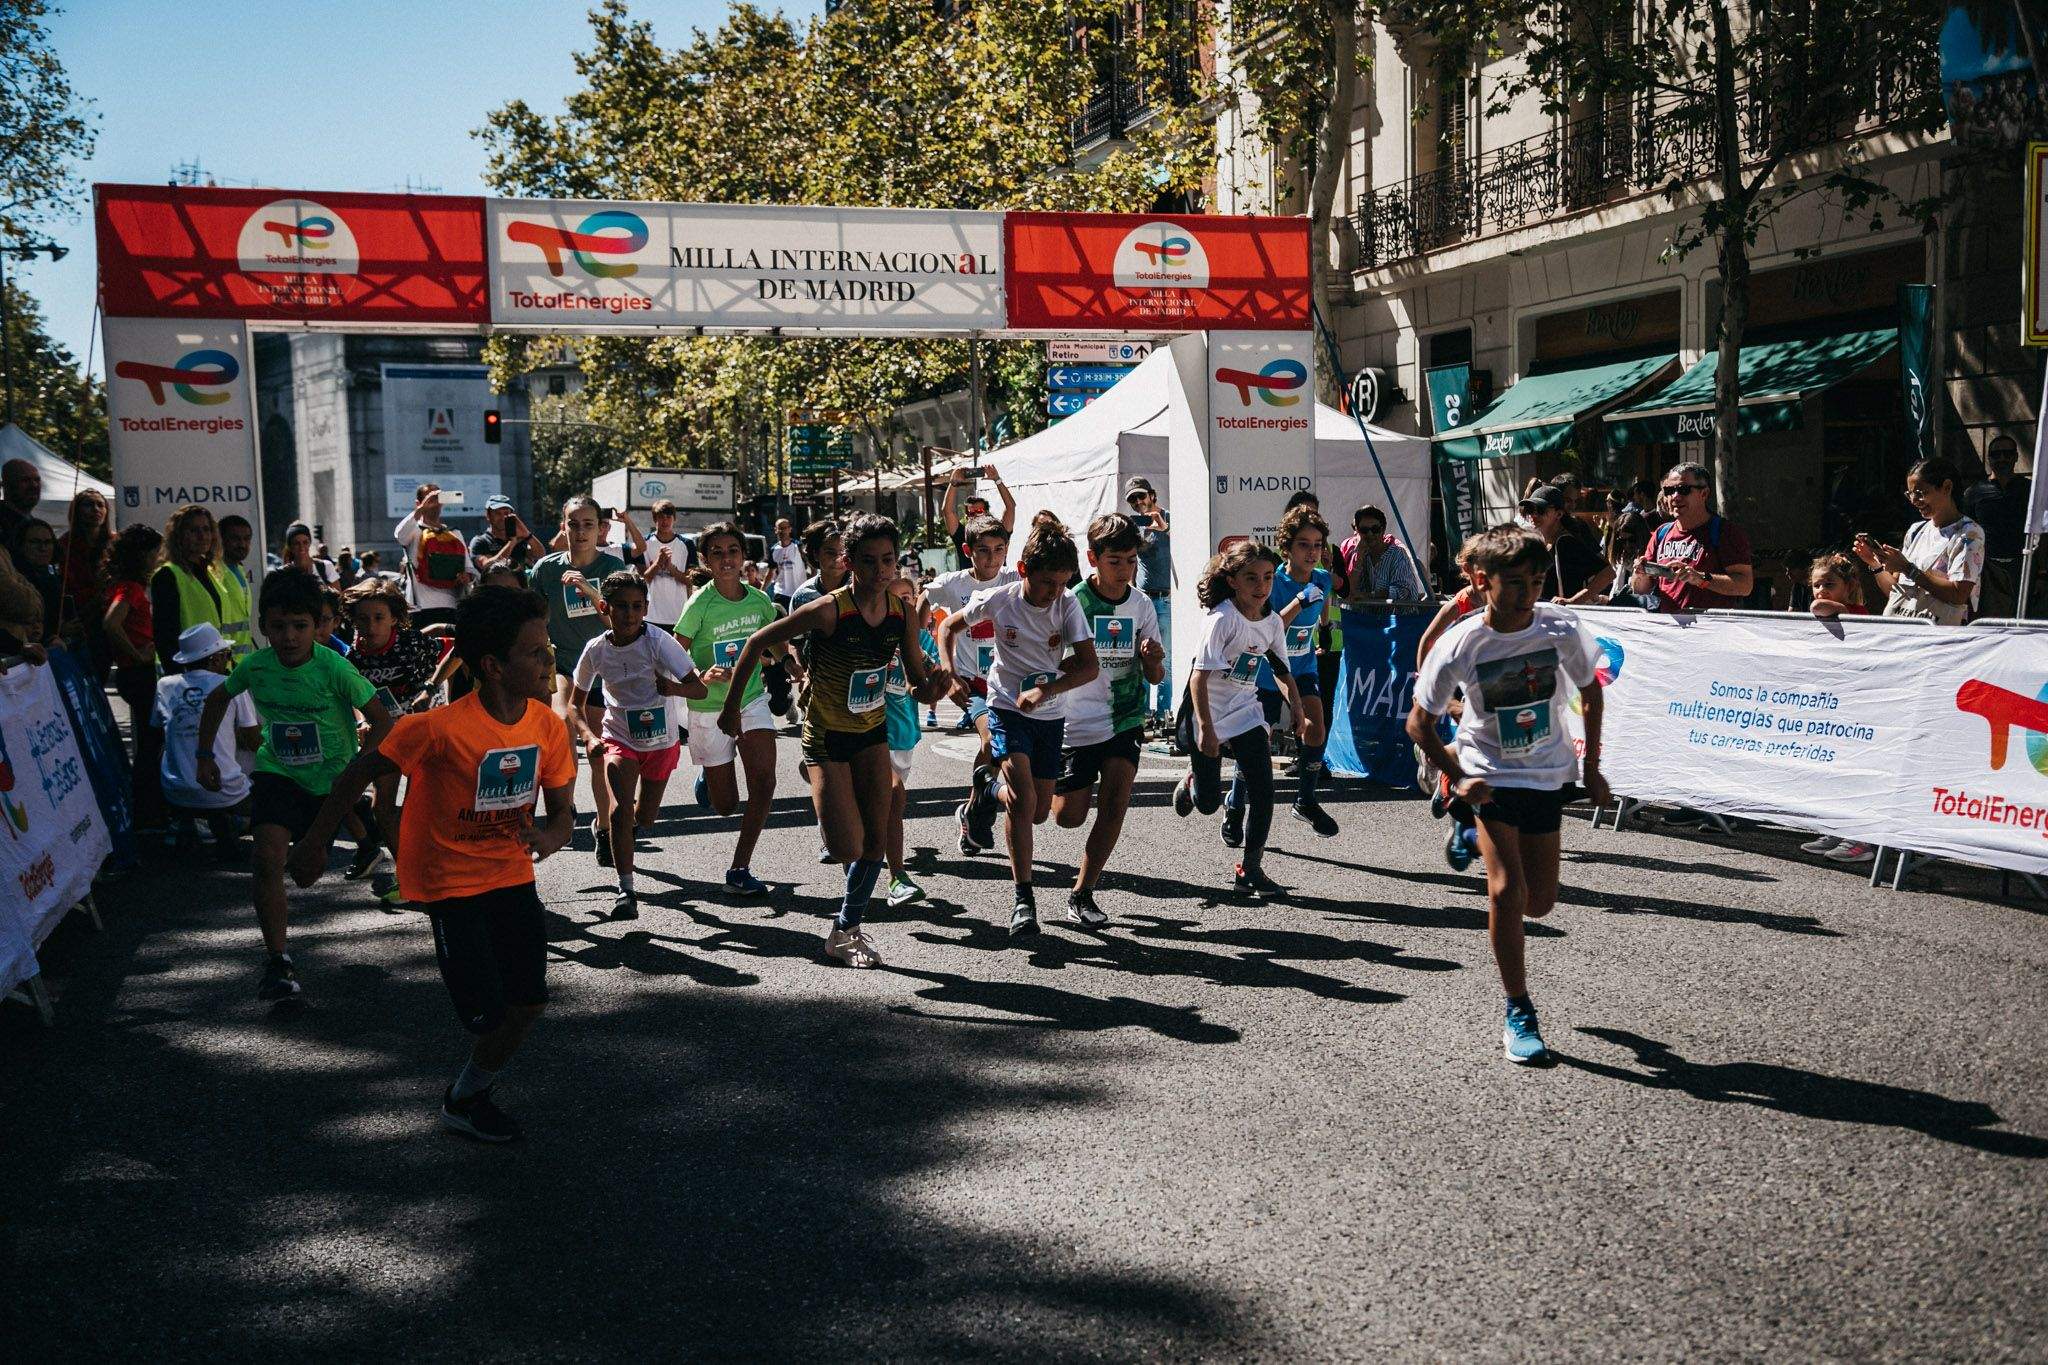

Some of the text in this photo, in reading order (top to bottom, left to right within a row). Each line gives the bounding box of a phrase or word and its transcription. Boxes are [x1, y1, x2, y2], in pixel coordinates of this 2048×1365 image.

[265, 255, 337, 266] TotalEnergies
[670, 246, 764, 270] MILLA
[1135, 271, 1192, 282] TotalEnergies
[757, 278, 916, 302] DE MADRID
[1150, 289, 1176, 298] MILLA
[509, 291, 652, 314] TotalEnergies
[1140, 307, 1186, 315] DE MADRID
[1052, 351, 1079, 359] Retiro
[1075, 342, 1106, 351] Municipal
[119, 416, 244, 434] TotalEnergies
[1216, 417, 1308, 432] TotalEnergies
[1677, 412, 1716, 438] Bexley
[1485, 432, 1514, 456] Bexley
[1239, 476, 1311, 492] MADRID
[155, 486, 252, 504] MADRID
[1709, 681, 1839, 710] Somos la compañía
[1668, 700, 1874, 741] multienergías que patrocina
[1689, 729, 1836, 762] tus carreras preferidas
